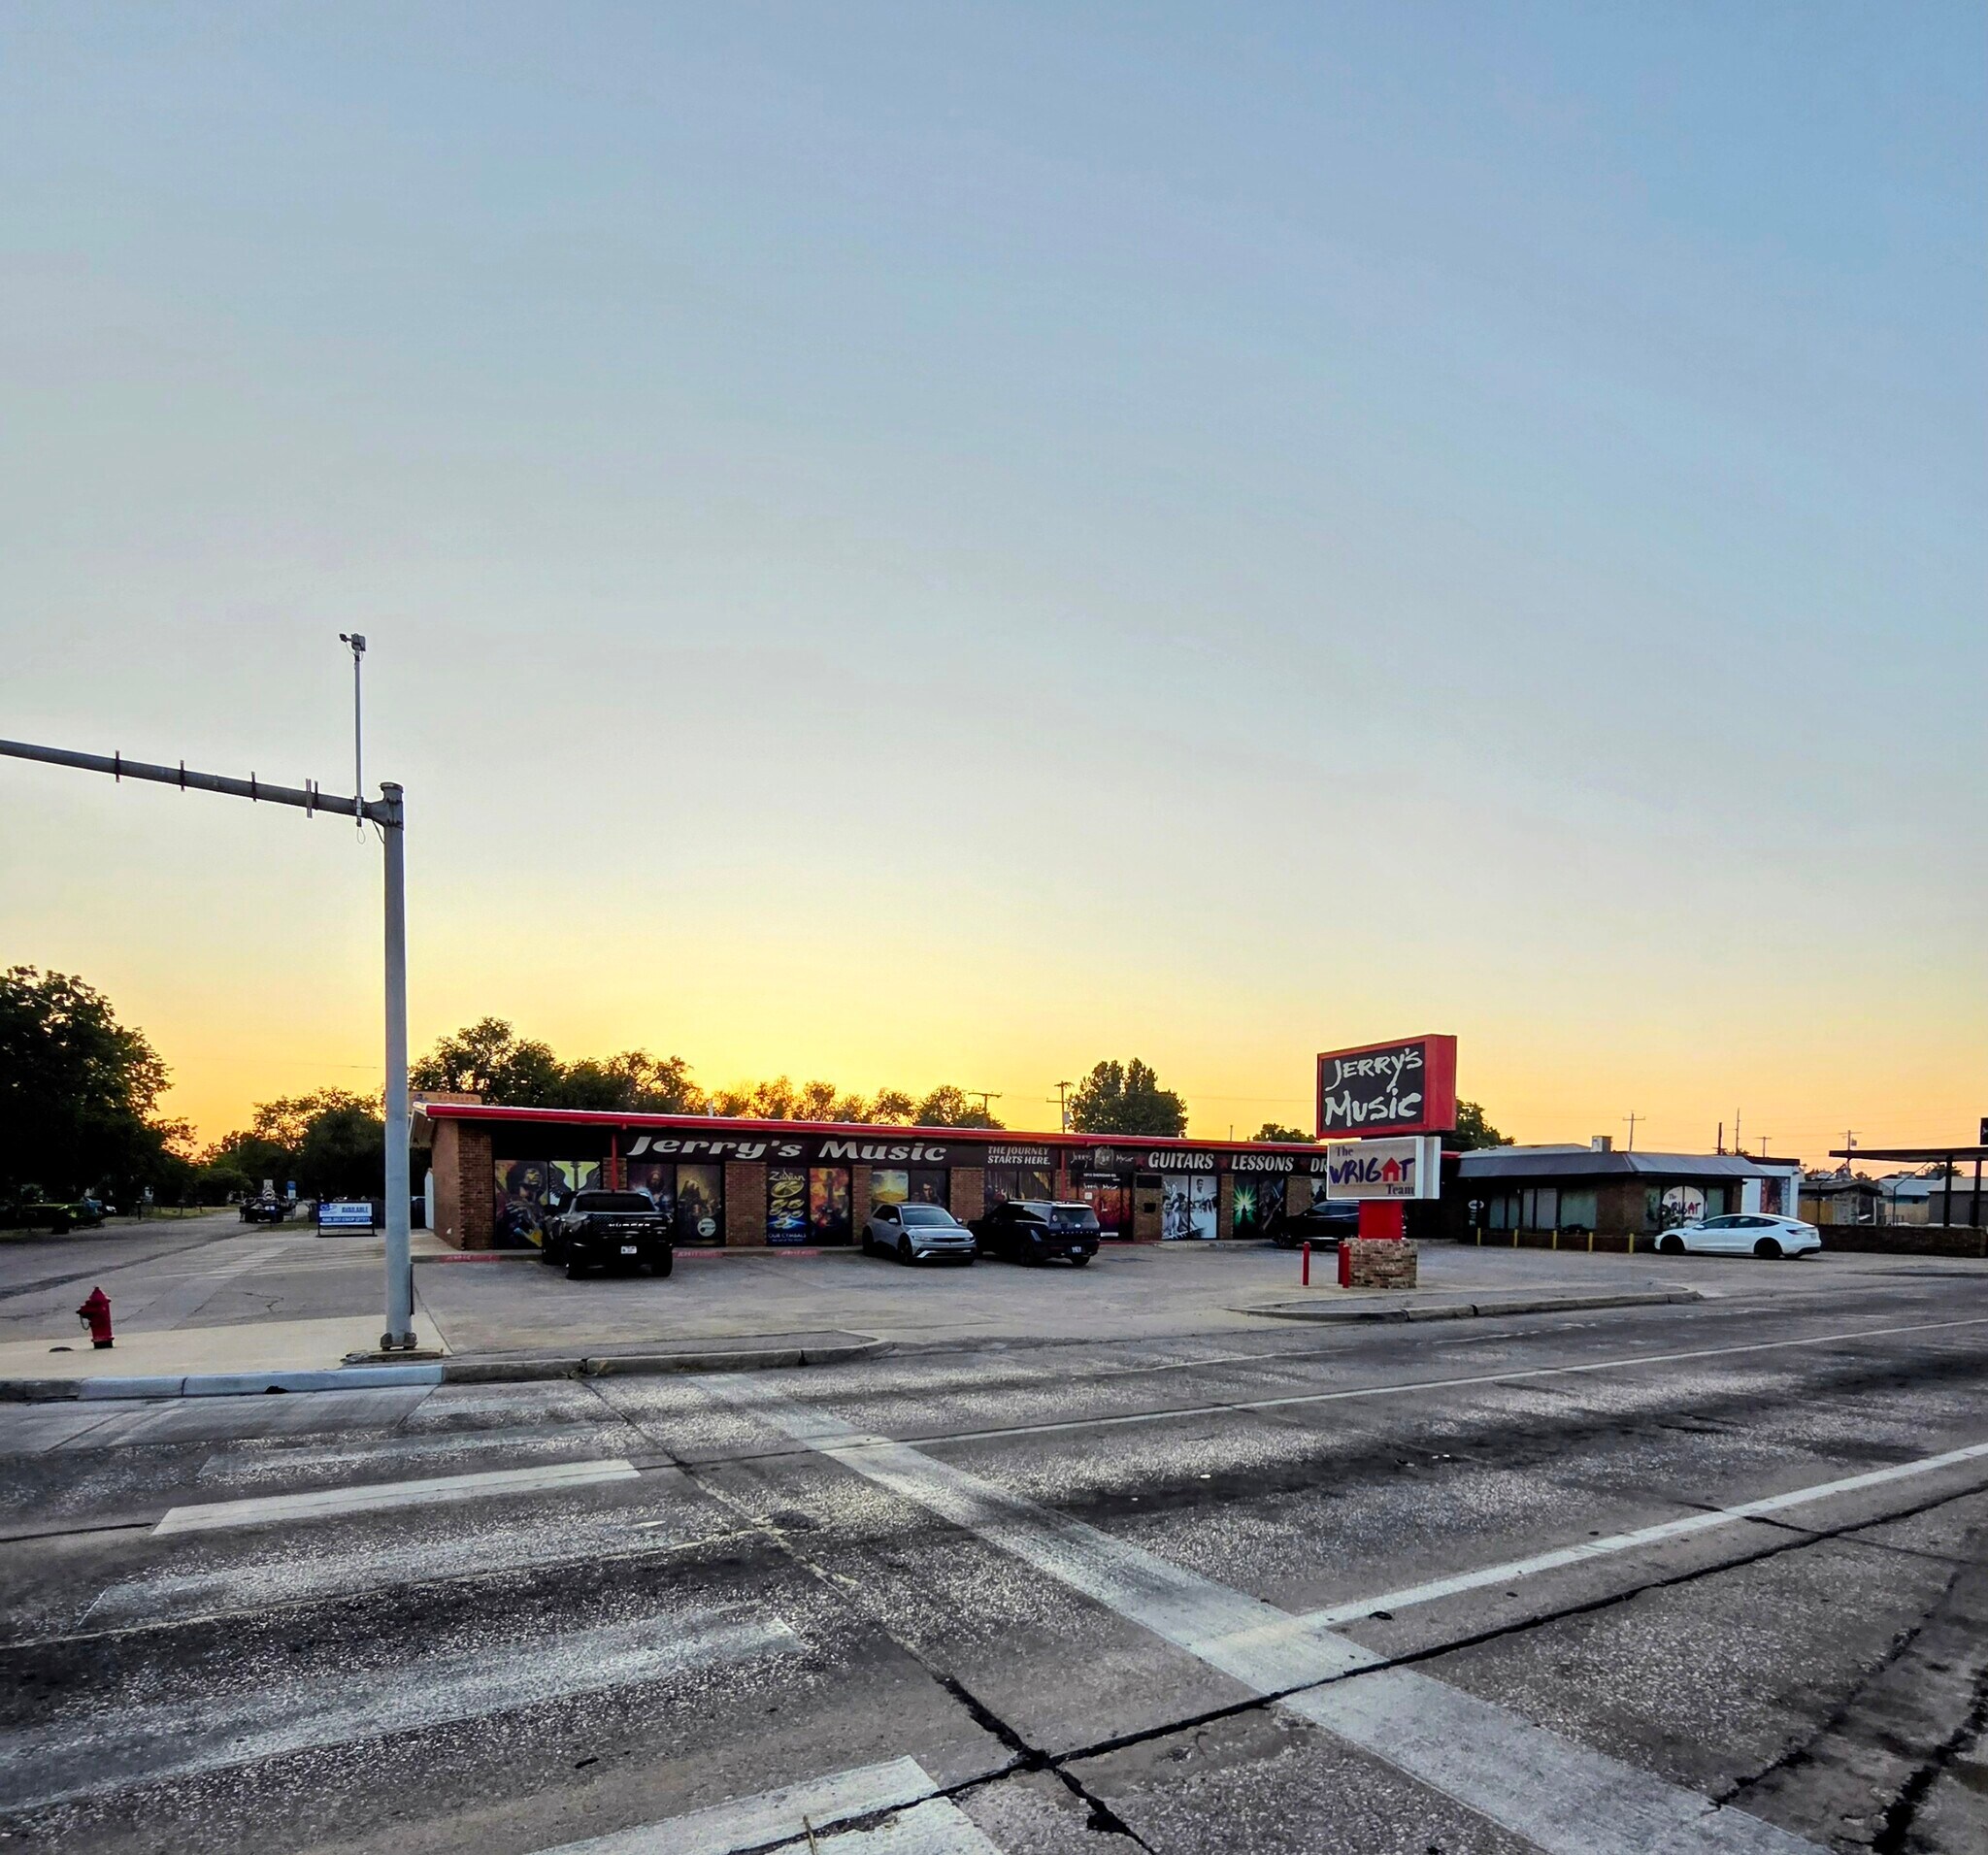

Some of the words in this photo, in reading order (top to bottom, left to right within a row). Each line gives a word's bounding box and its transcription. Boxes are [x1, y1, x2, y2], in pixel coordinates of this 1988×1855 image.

[626, 1136, 803, 1159] Jerry's
[818, 1141, 947, 1162] Music
[988, 1146, 1006, 1155] THE
[1007, 1146, 1049, 1156] JOURNEY
[1335, 1145, 1354, 1157] The
[987, 1155, 1023, 1165] STARTS
[1148, 1151, 1214, 1170] GUITARS
[1231, 1154, 1294, 1173] LESSONS
[1386, 1183, 1415, 1195] Team
